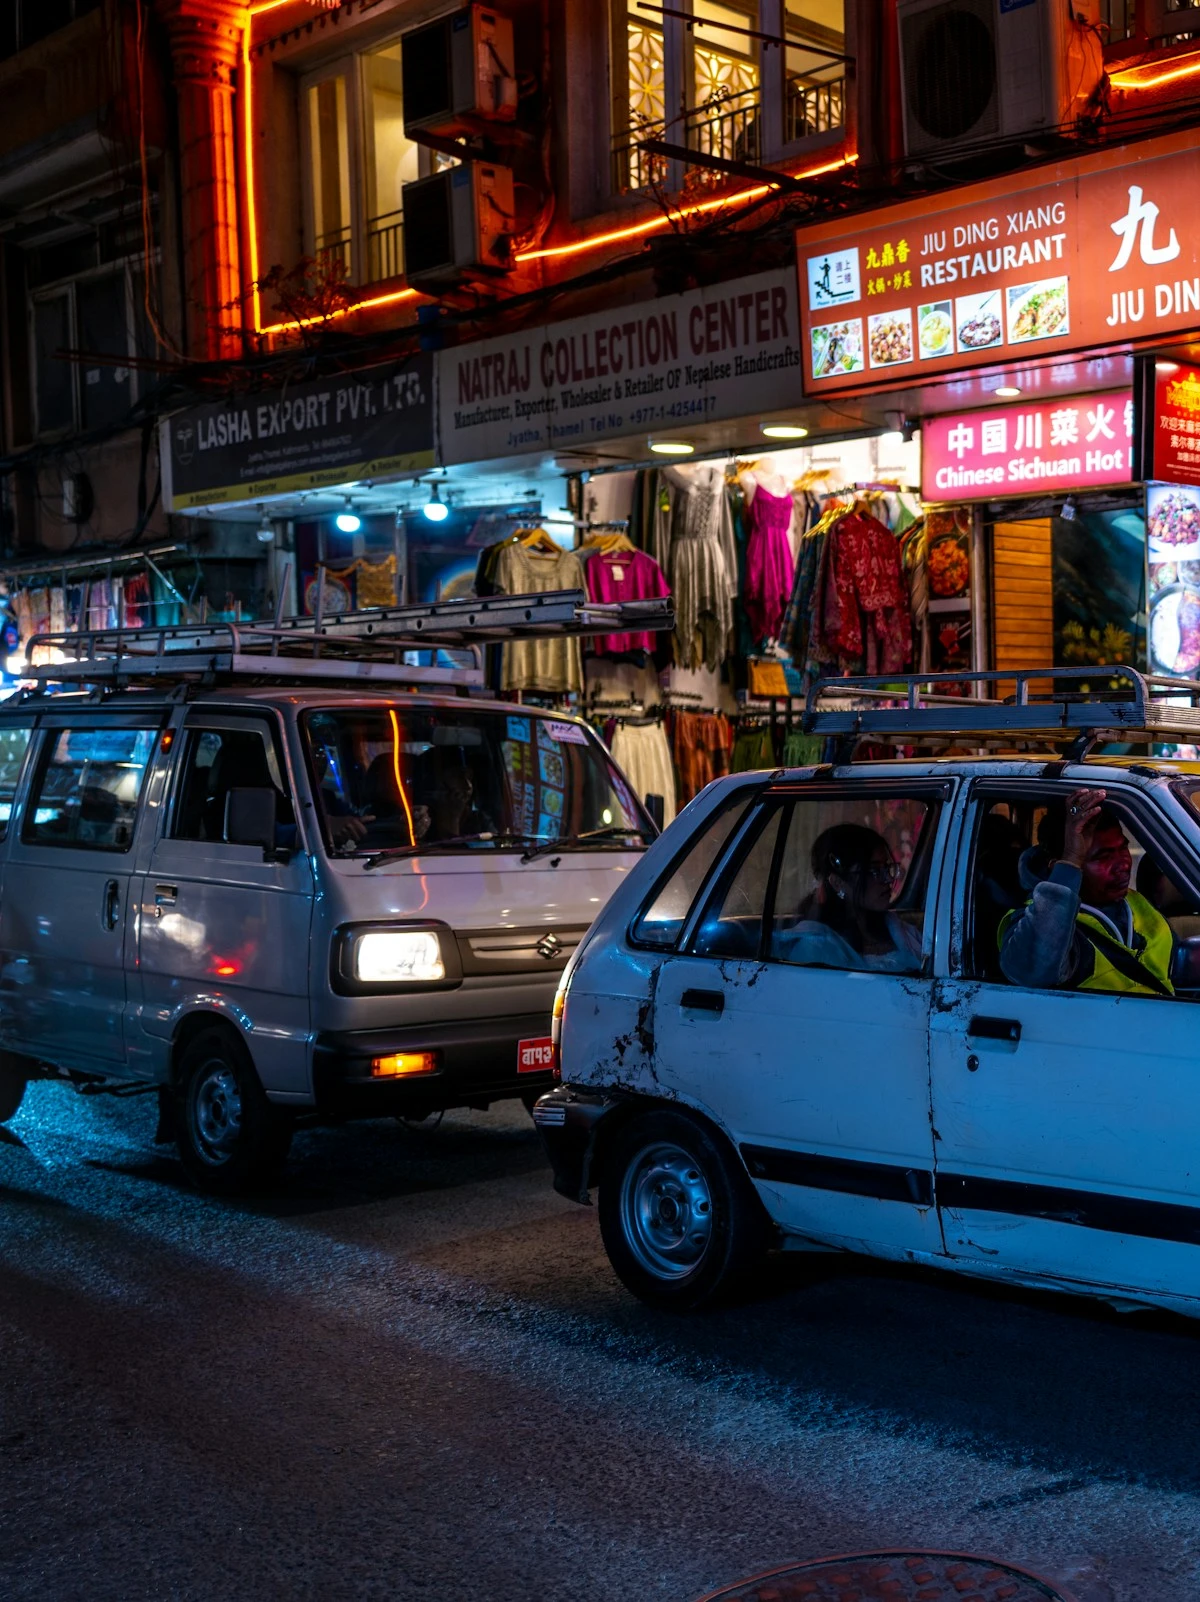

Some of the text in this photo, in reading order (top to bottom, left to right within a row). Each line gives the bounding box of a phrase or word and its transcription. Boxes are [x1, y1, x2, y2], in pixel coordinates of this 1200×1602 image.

[866, 239, 911, 269] 九鼎香
[920, 202, 1066, 256] JIU DING XIANG
[921, 233, 1066, 287] RESTAURANT
[1106, 288, 1145, 327] JIU
[458, 286, 789, 406] NATRAJ COLLECTION CENTER
[198, 410, 253, 450] LASHA
[257, 392, 331, 438] EXPORT
[336, 384, 377, 423] PVT.
[384, 371, 425, 412] LTD.
[454, 347, 800, 430] Manufacturer, Exporter, Wholesaler & Retailer OF Nepalese Handicrafts
[549, 418, 584, 439] Thamel
[935, 464, 1004, 490] Chinese
[1008, 456, 1080, 481] Sichuan
[1085, 448, 1123, 473] Hot
